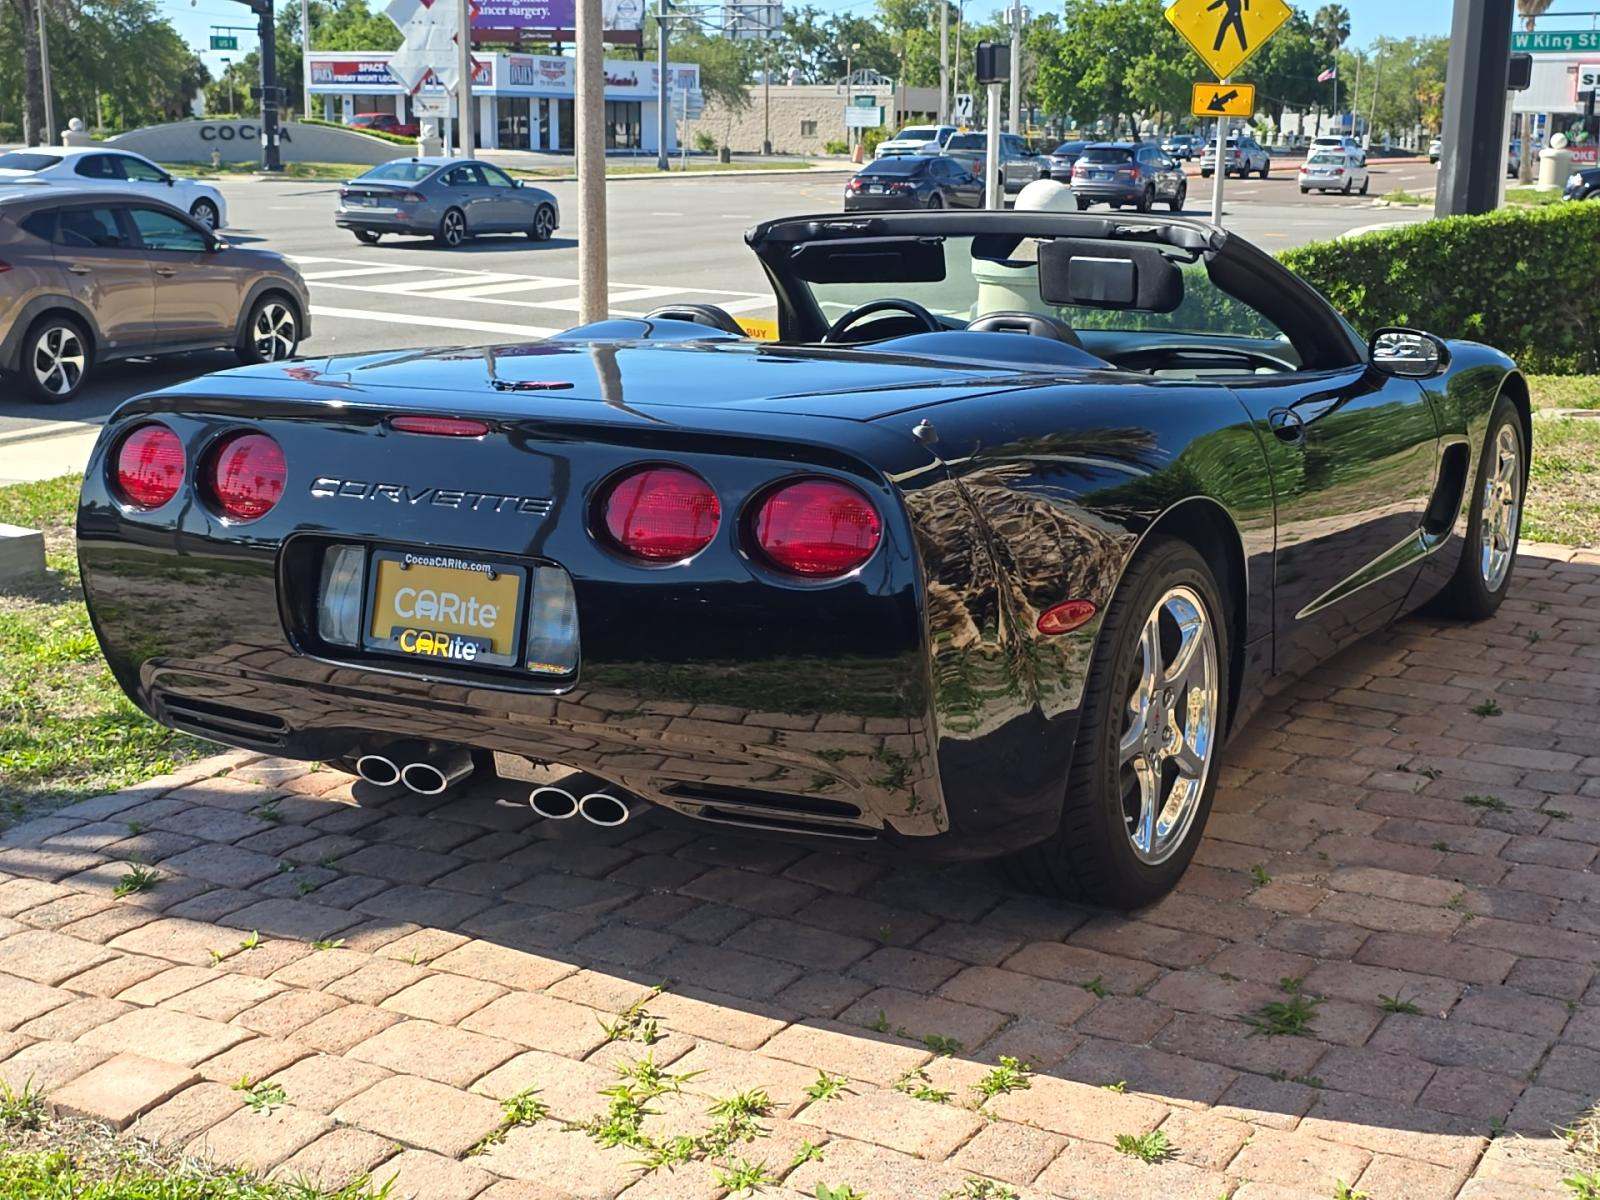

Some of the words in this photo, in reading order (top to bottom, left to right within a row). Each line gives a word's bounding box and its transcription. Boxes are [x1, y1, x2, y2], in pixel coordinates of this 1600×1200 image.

[508, 6, 551, 20] surgery.
[1516, 35, 1528, 48] W
[1533, 34, 1573, 50] King
[1578, 33, 1598, 47] St
[358, 63, 385, 72] SPACE
[200, 124, 292, 143] COCA
[746, 328, 767, 338] BUY
[310, 476, 553, 516] CORVETTE
[405, 553, 492, 573] CocoaCARite.com
[394, 586, 498, 629] CARite
[400, 628, 478, 661] CARite
